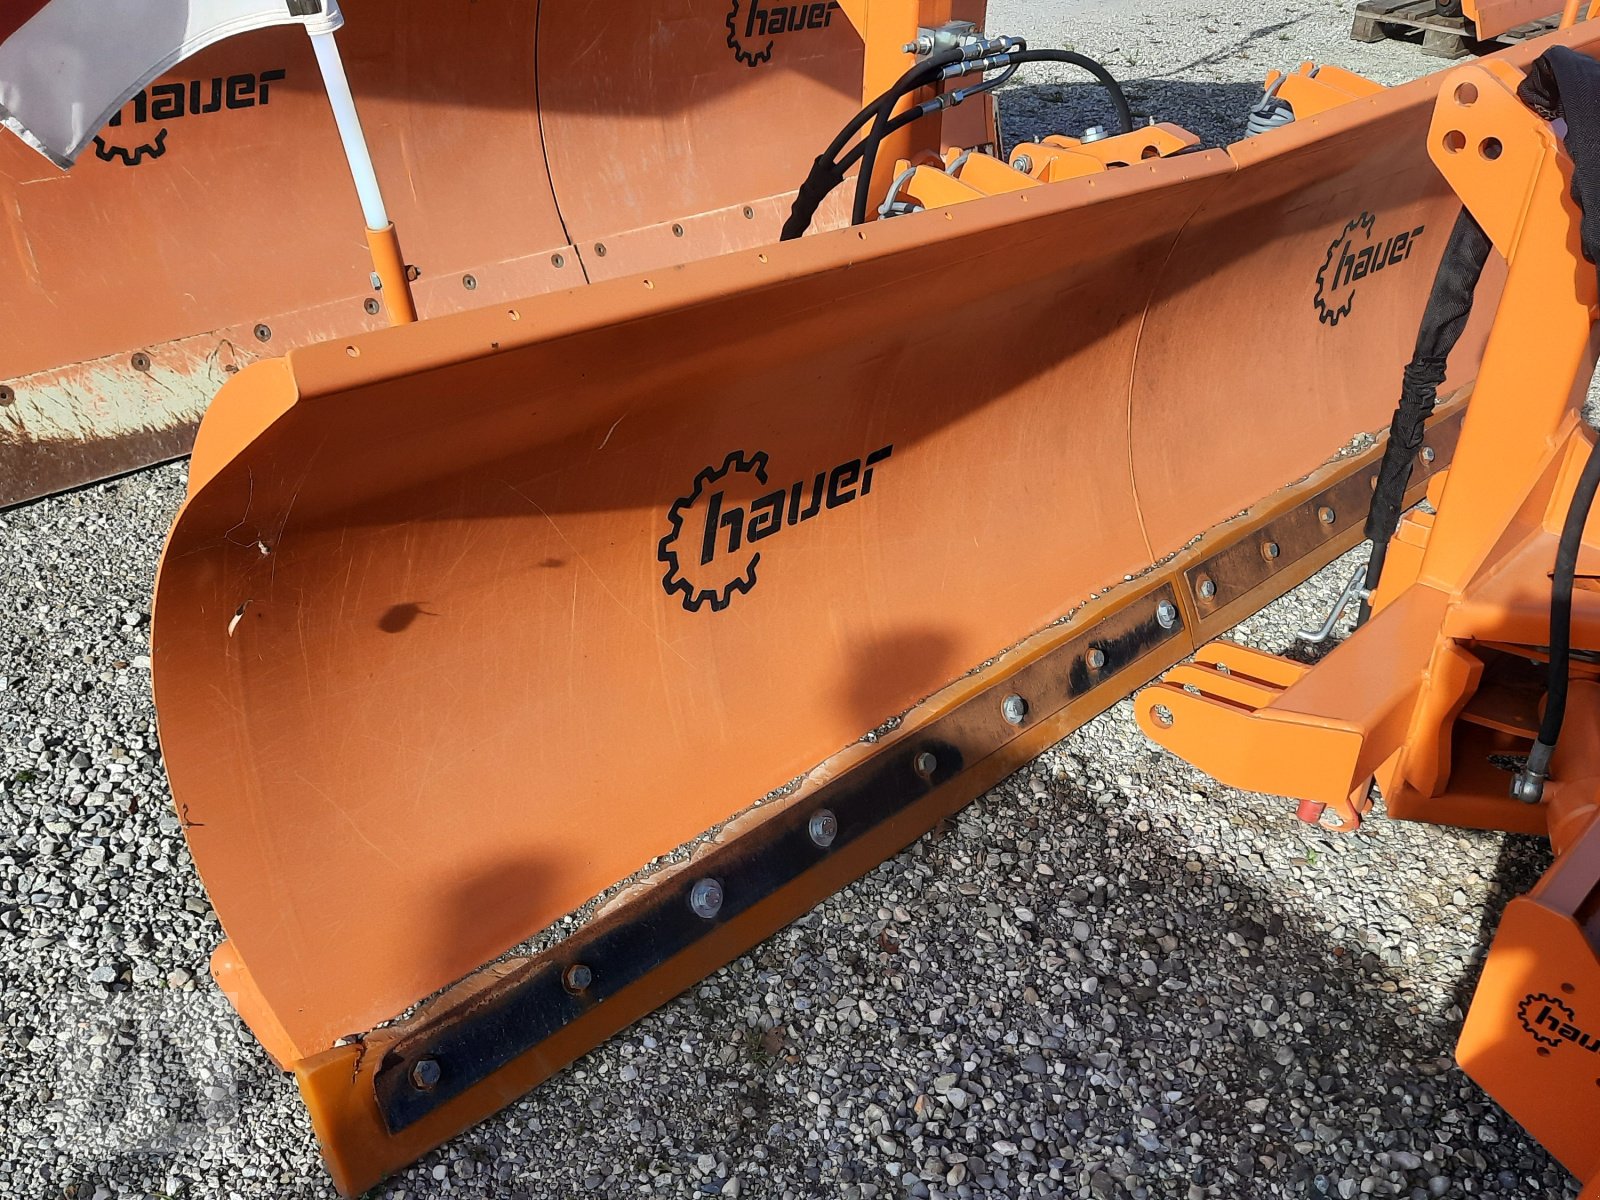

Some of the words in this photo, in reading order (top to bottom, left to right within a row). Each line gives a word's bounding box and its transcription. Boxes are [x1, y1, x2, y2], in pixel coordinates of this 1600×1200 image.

[1331, 225, 1425, 291] hauer
[700, 444, 894, 566] hauer
[1535, 1005, 1600, 1053] hau
